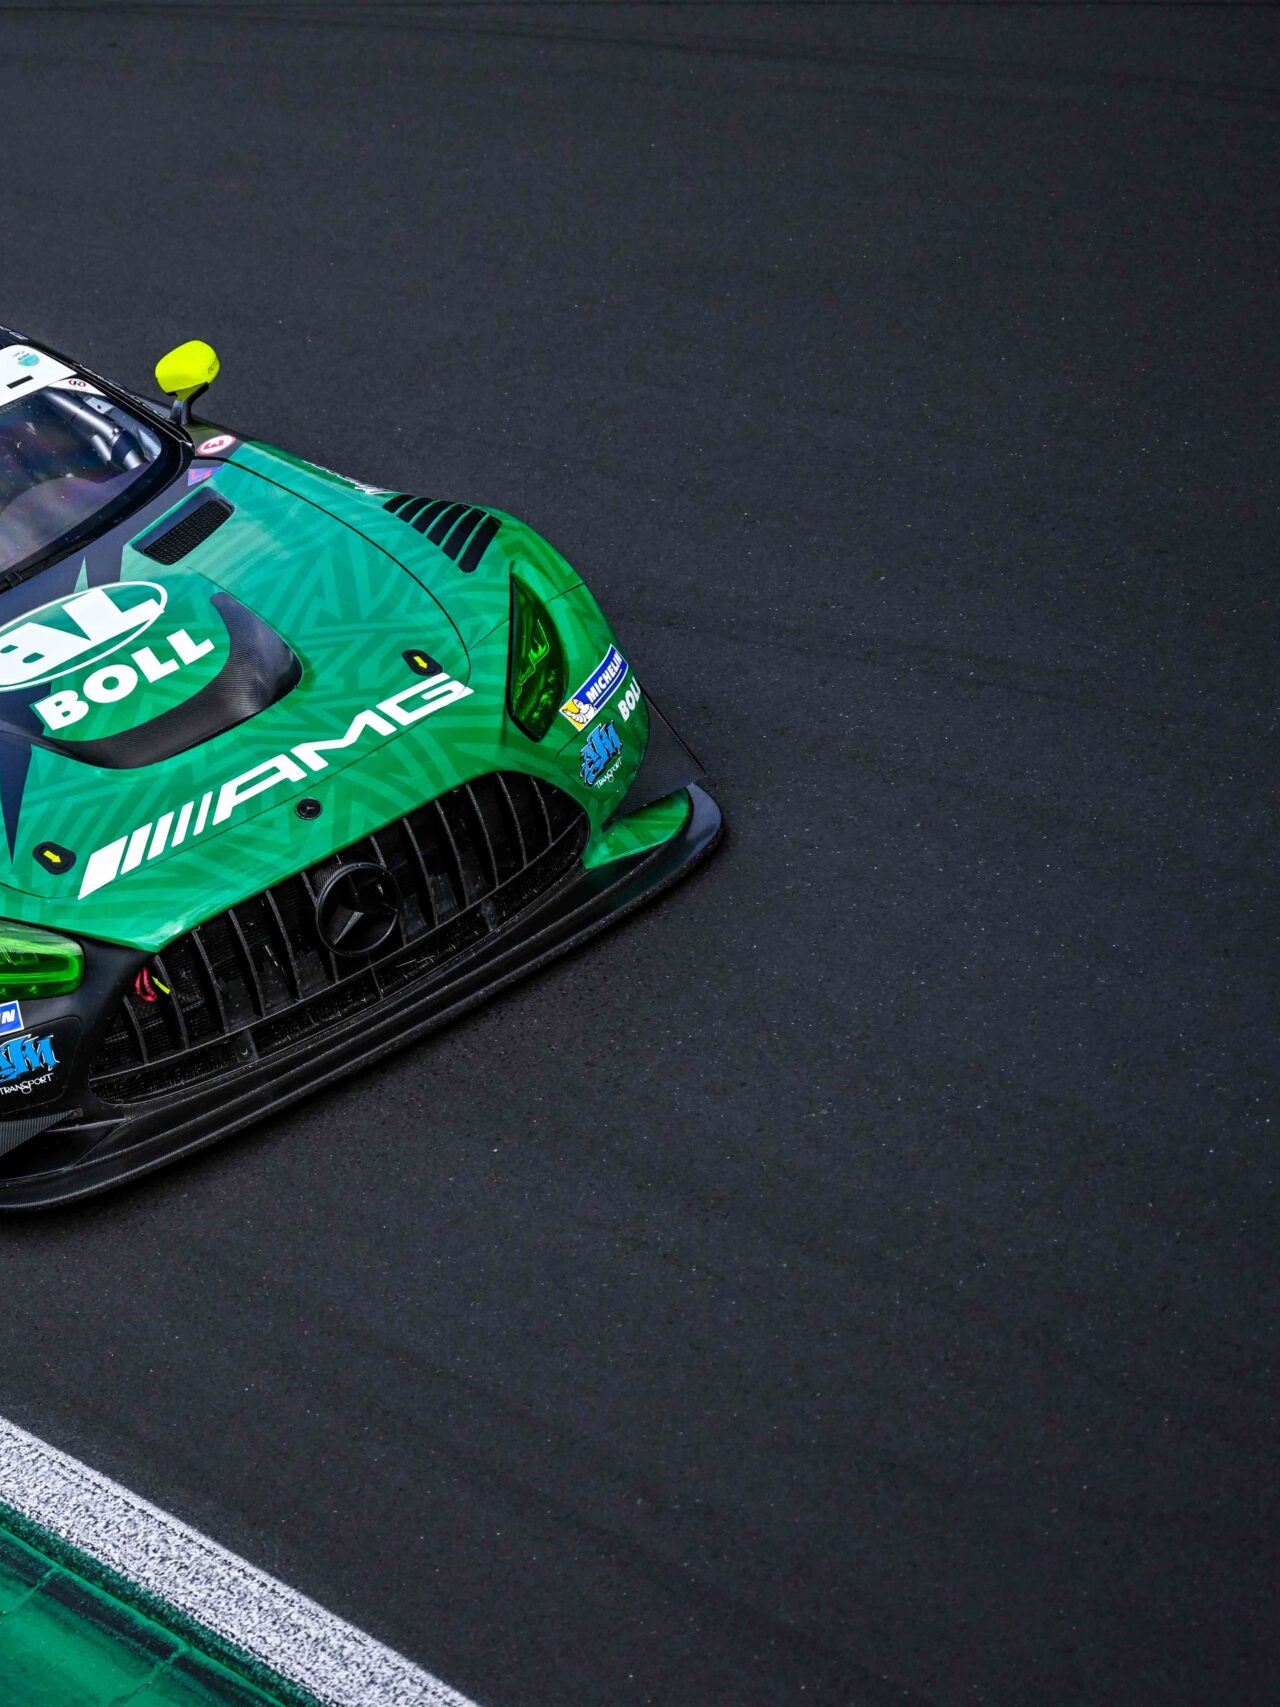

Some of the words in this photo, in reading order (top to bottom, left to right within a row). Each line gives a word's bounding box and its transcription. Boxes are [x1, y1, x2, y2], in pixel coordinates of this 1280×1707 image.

[34, 628, 216, 731] BOLL
[586, 651, 623, 703] MICHELIN
[212, 672, 475, 825] AMG
